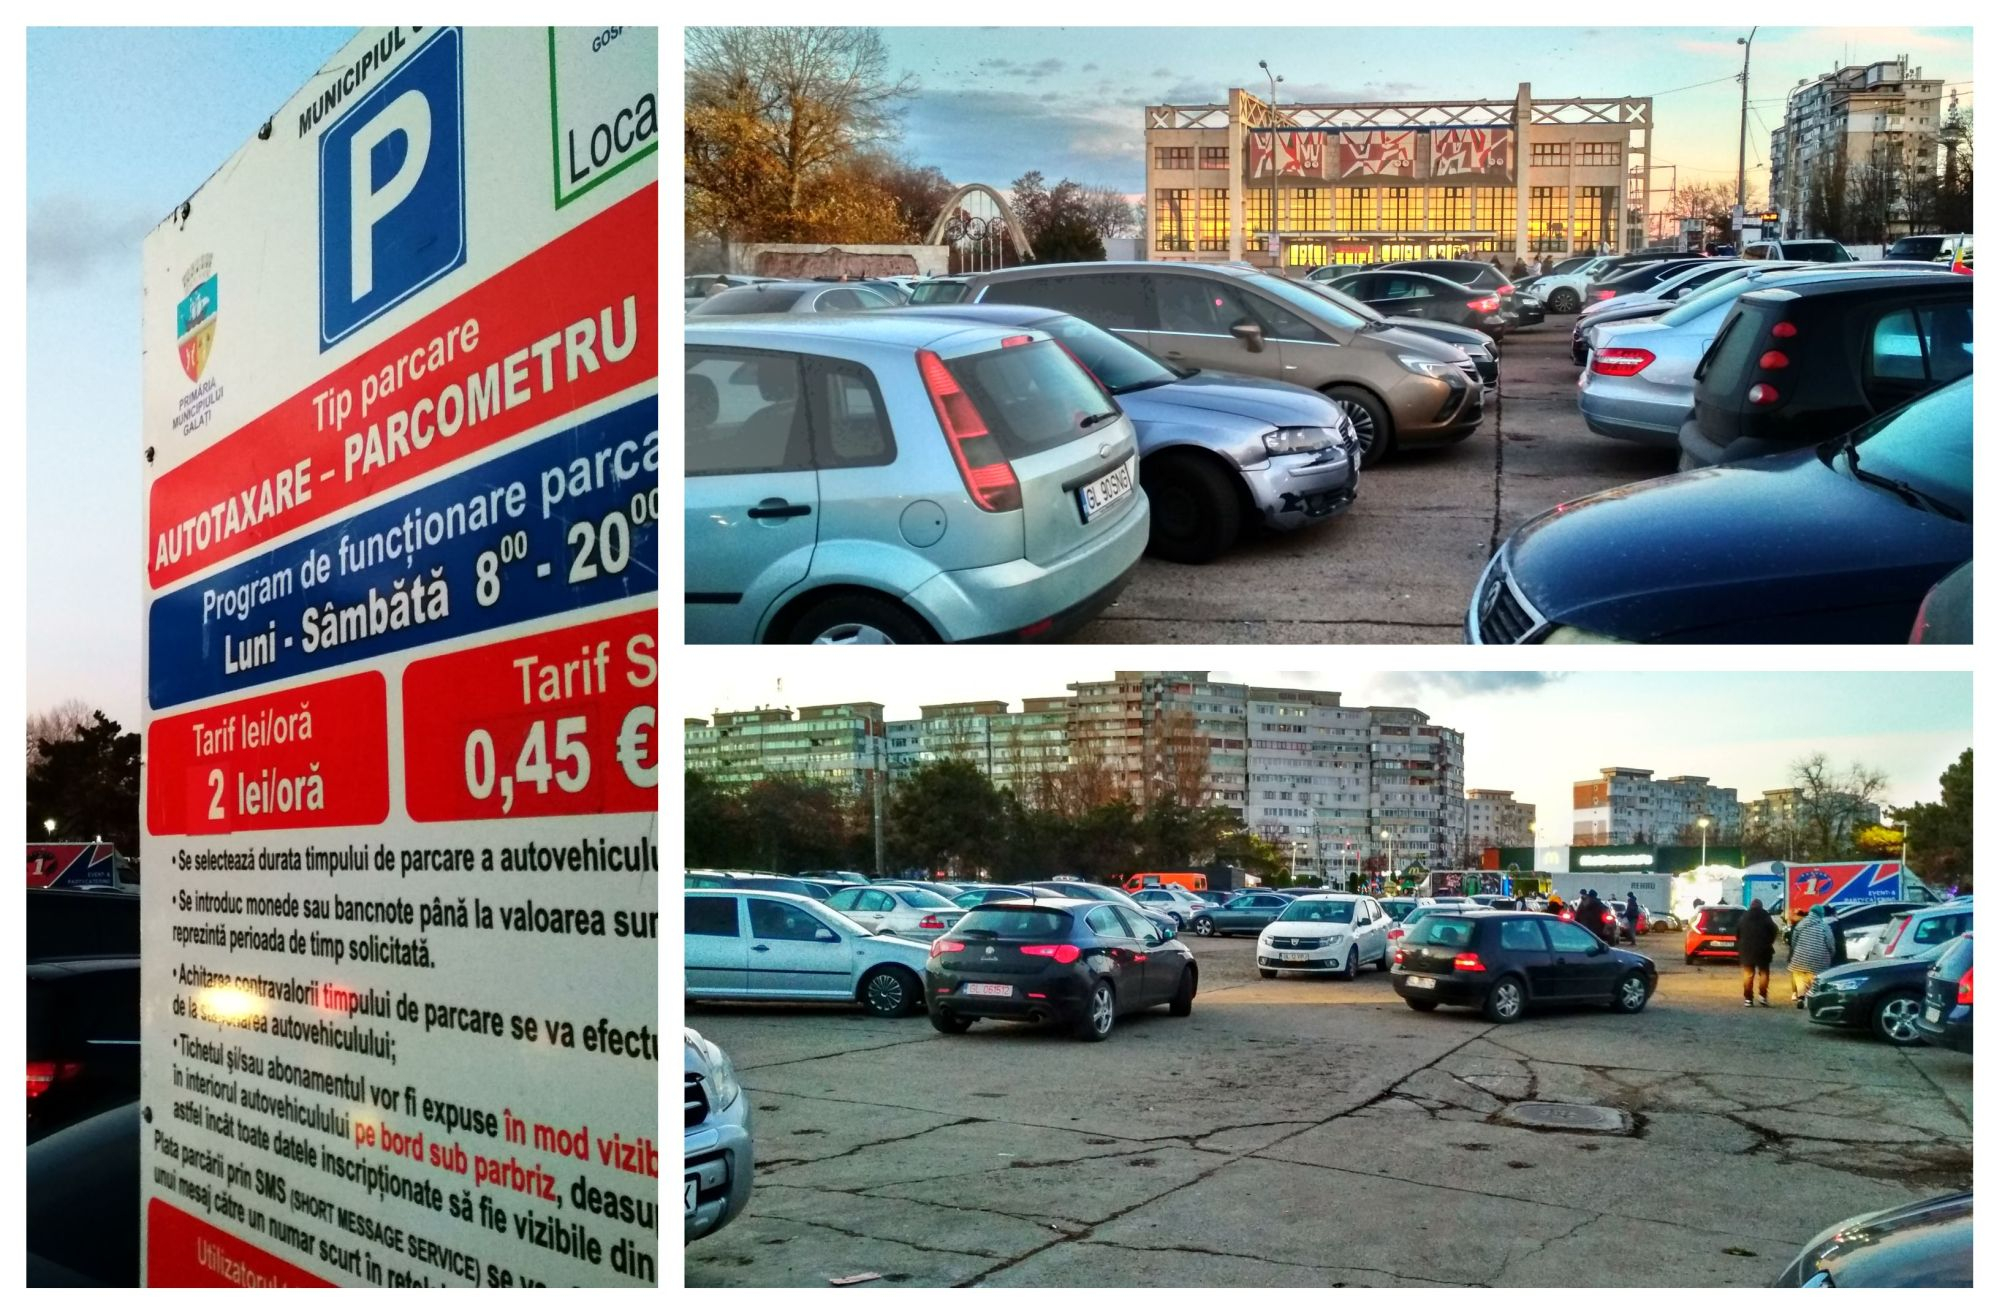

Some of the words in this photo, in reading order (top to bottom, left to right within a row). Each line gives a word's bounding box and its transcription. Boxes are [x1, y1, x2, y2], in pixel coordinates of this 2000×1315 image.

[298, 26, 406, 139] MUNICIPIUL
[568, 92, 658, 184] Loca
[350, 89, 432, 302] P
[172, 386, 225, 430] MUNICIPIULUI
[311, 387, 353, 433] Tip
[361, 318, 480, 410] parcare
[154, 458, 313, 572] AUTOTAXARE
[344, 295, 638, 484] PARCOMETRU
[202, 568, 294, 625] Program
[300, 549, 332, 588] de
[338, 480, 527, 568] funcționare
[541, 430, 658, 507] parca
[1086, 486, 1101, 510] GL
[224, 621, 277, 675] Luni
[301, 568, 449, 654] Sâmbătă
[513, 641, 609, 706] Tarif
[626, 633, 658, 688] S
[193, 714, 236, 758] Tarif
[241, 701, 313, 749] lei/oră
[464, 716, 592, 814] 0,45
[616, 705, 658, 788] €
[207, 768, 226, 820] 2
[238, 763, 324, 815] lei/oră
[178, 849, 193, 871] Se
[195, 847, 255, 871] selectează
[259, 846, 302, 871] durata
[305, 845, 369, 877] timpului
[374, 843, 396, 872] de
[402, 847, 475, 879] parcare
[481, 848, 494, 871] a
[1803, 877, 1818, 895] 1
[173, 922, 227, 948] reprezintă
[230, 926, 286, 953] perioada
[289, 929, 306, 955] de
[310, 930, 344, 965] timp
[349, 934, 435, 969] solicitată.
[179, 889, 193, 912] Se
[195, 890, 243, 915] introduc
[246, 892, 299, 918] monede
[303, 897, 330, 920] sau
[335, 893, 414, 925] bancnote
[420, 896, 469, 932] până
[475, 898, 494, 930] la
[500, 900, 606, 936] valoarea
[173, 993, 186, 1016] de
[188, 995, 198, 1018] la
[272, 1013, 396, 1066] autovehiculului;
[179, 963, 231, 989] Achitarea
[235, 973, 320, 1008] contravalorii
[324, 981, 391, 1018] timpului
[396, 993, 419, 1023] de
[425, 1001, 504, 1037] parcare
[511, 1014, 538, 1042] se
[545, 1018, 575, 1048] va
[180, 1033, 224, 1066] Tichetul
[268, 1055, 366, 1104] abonamentul
[370, 1085, 400, 1112] vor
[404, 1086, 417, 1118] fi
[422, 1097, 498, 1138] expuse
[503, 1108, 527, 1147] în
[533, 1123, 590, 1162] mod
[597, 1132, 658, 1179] vizib
[186, 1066, 237, 1105] interiorul
[241, 1087, 350, 1140] autovehiculului
[355, 1121, 376, 1149] pe
[381, 1121, 424, 1162] bord
[430, 1142, 468, 1176] sub
[475, 1154, 563, 1210] parbriz,
[571, 1174, 658, 1241] deasu
[154, 1129, 180, 1161] Plata
[182, 1144, 225, 1179] parcării
[227, 1161, 252, 1191] prin
[255, 1168, 287, 1205] SMS
[290, 1188, 335, 1225] (SHORT
[337, 1206, 404, 1252] MESSAGE
[407, 1233, 481, 1288] SERVICE)
[487, 1264, 514, 1288] se
[154, 1166, 177, 1192] unui
[179, 1177, 212, 1215] mesaj
[214, 1191, 246, 1224] către
[248, 1207, 266, 1234] un
[269, 1217, 316, 1256] numar
[319, 1239, 362, 1278] scurt
[365, 1251, 383, 1288] în
[174, 1099, 202, 1127] astfel
[237, 1118, 270, 1151] toate
[273, 1130, 318, 1168] datele
[449, 1188, 474, 1224] să
[479, 1195, 507, 1234] fie
[513, 1209, 603, 1266] vizibile
[610, 1237, 656, 1284] din
